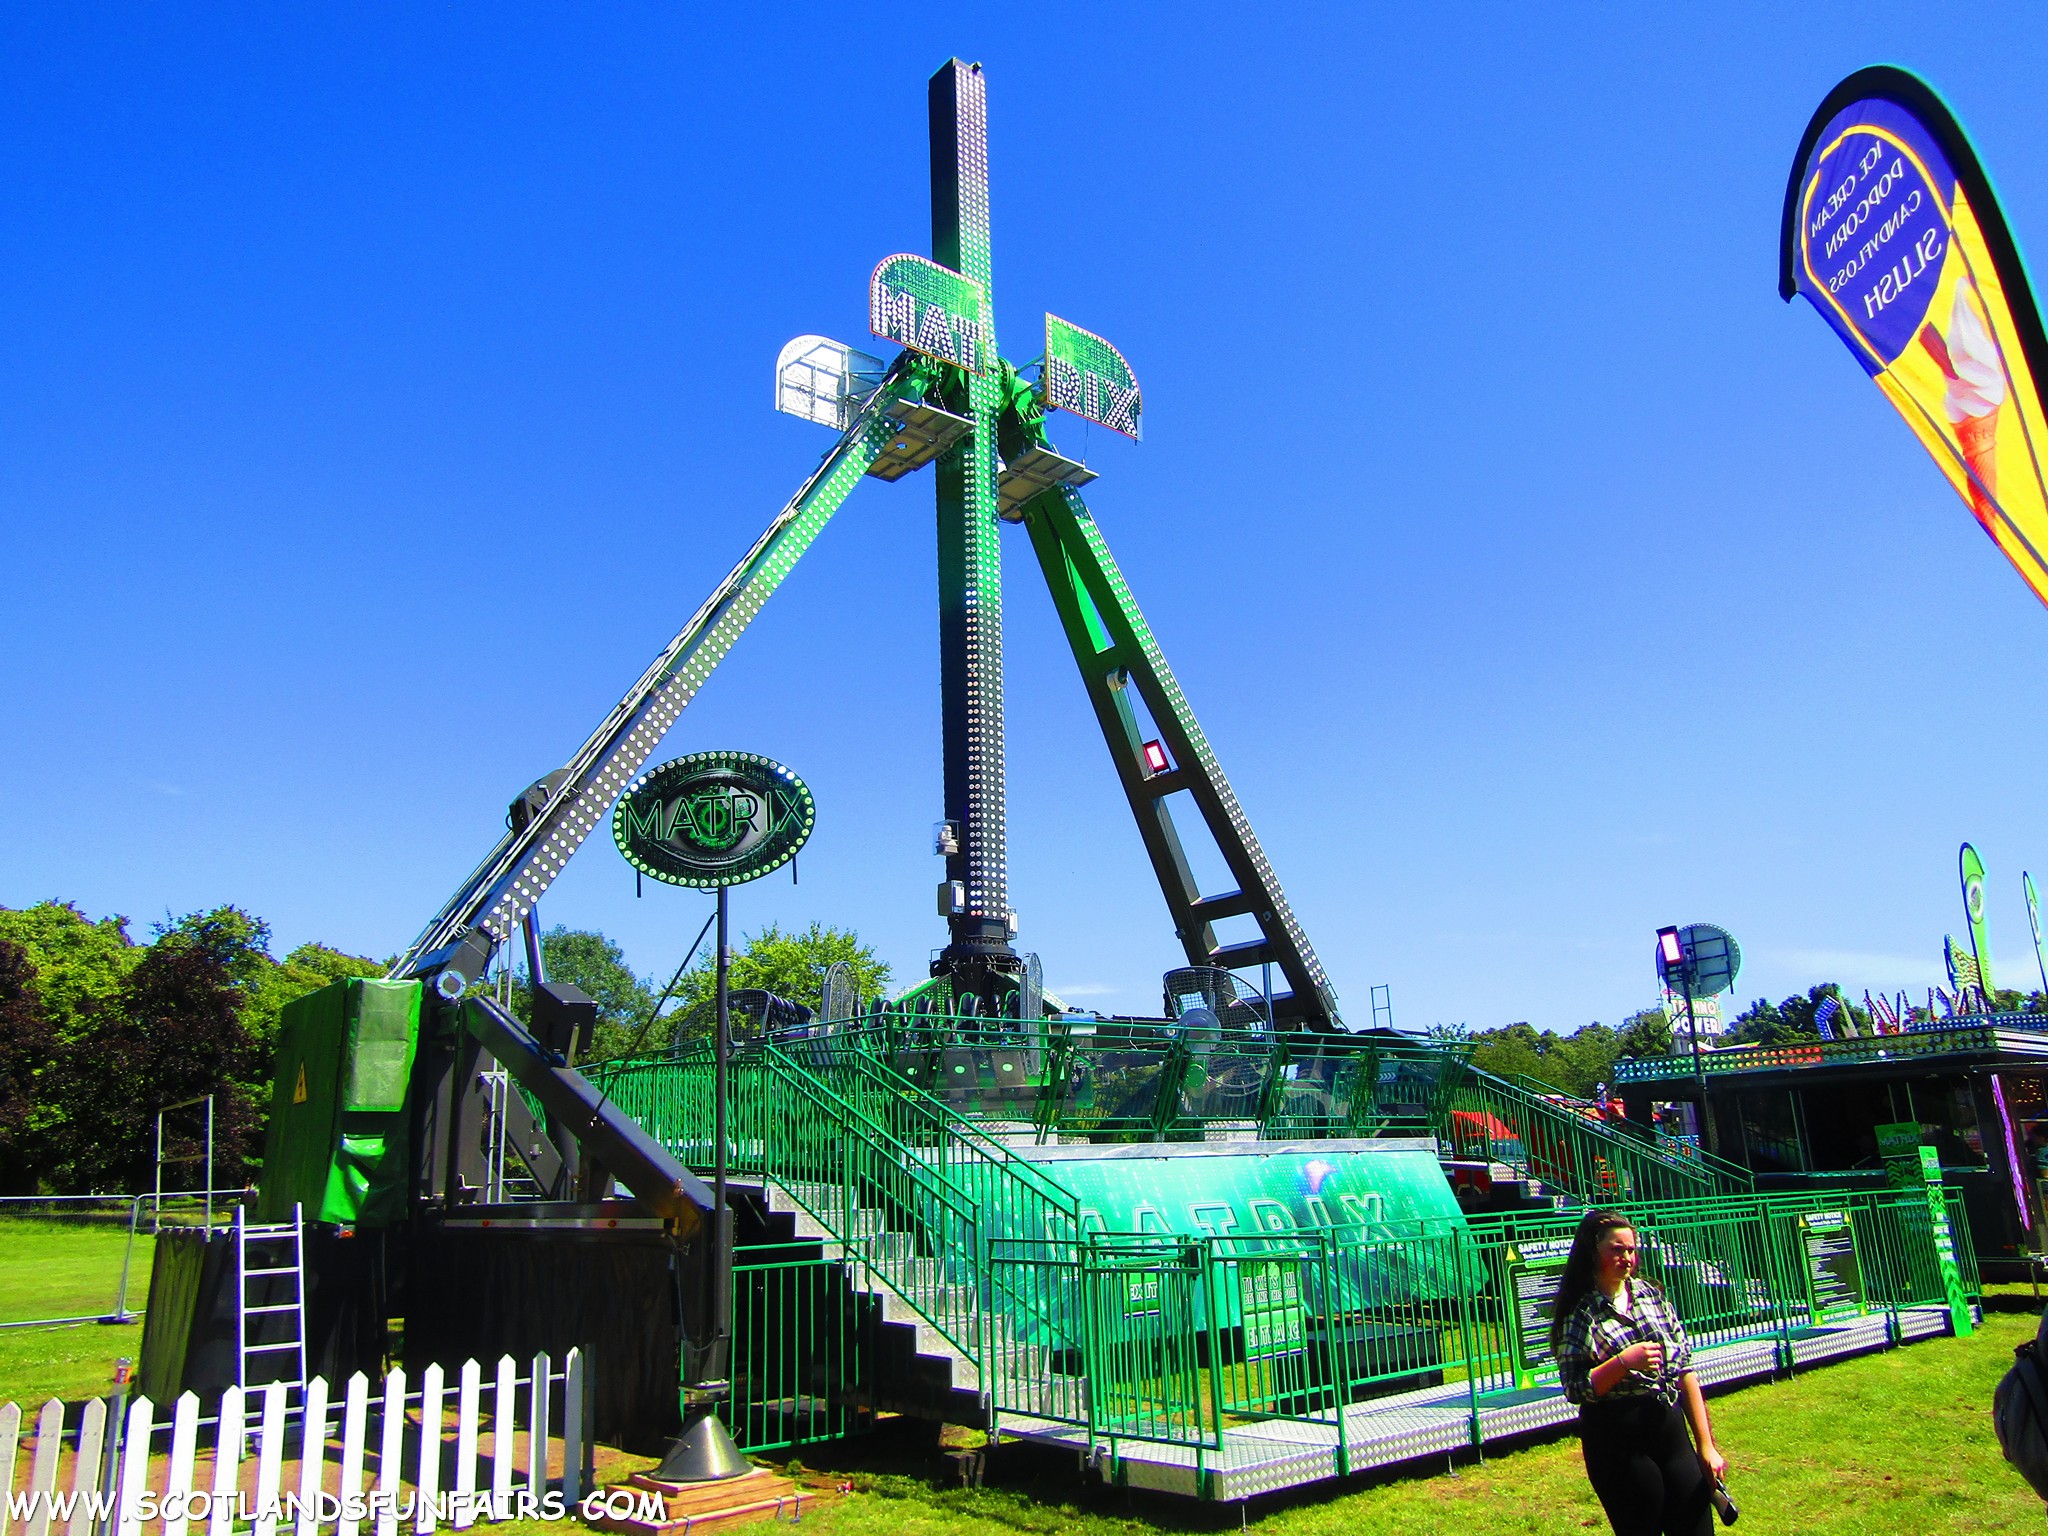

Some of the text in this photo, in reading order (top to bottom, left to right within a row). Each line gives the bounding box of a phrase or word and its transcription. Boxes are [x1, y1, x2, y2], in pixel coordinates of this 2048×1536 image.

[872, 281, 983, 371] MAT
[1049, 354, 1139, 437] RIX
[624, 790, 807, 843] MATRIX
[1671, 1000, 1717, 1015] TEHNO
[1671, 1015, 1721, 1034] POWER
[1044, 1193, 1403, 1280] MATRIX
[1518, 1238, 1575, 1254] SAFETY NOTIC
[1129, 1281, 1158, 1301] EXIT
